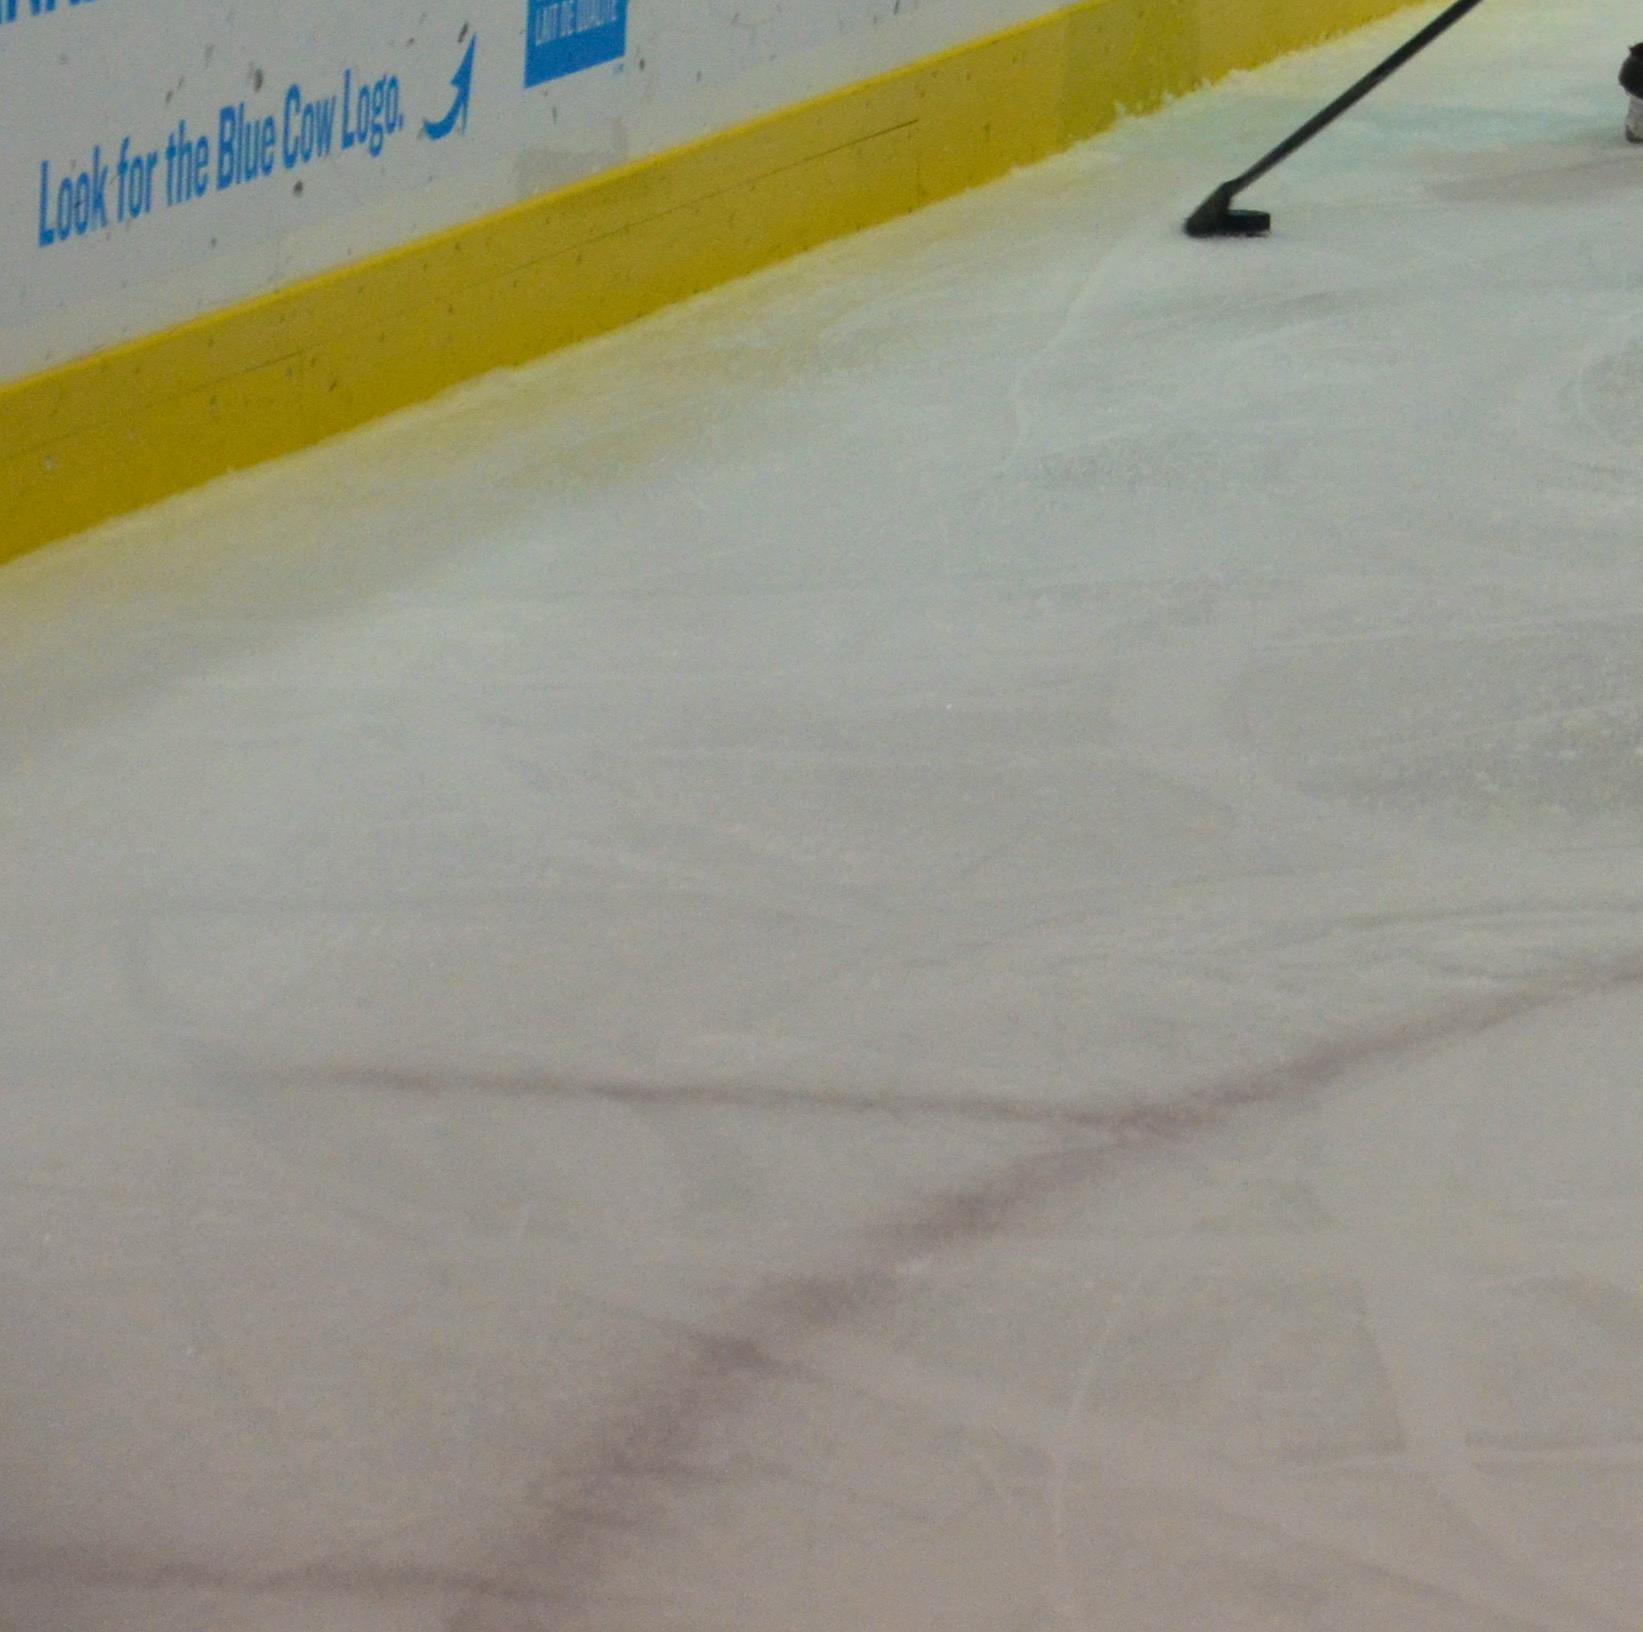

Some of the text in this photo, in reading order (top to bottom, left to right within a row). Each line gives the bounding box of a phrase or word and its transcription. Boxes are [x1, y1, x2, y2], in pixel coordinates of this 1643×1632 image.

[38, 69, 404, 248] Look for the Blue Cow Logo.
